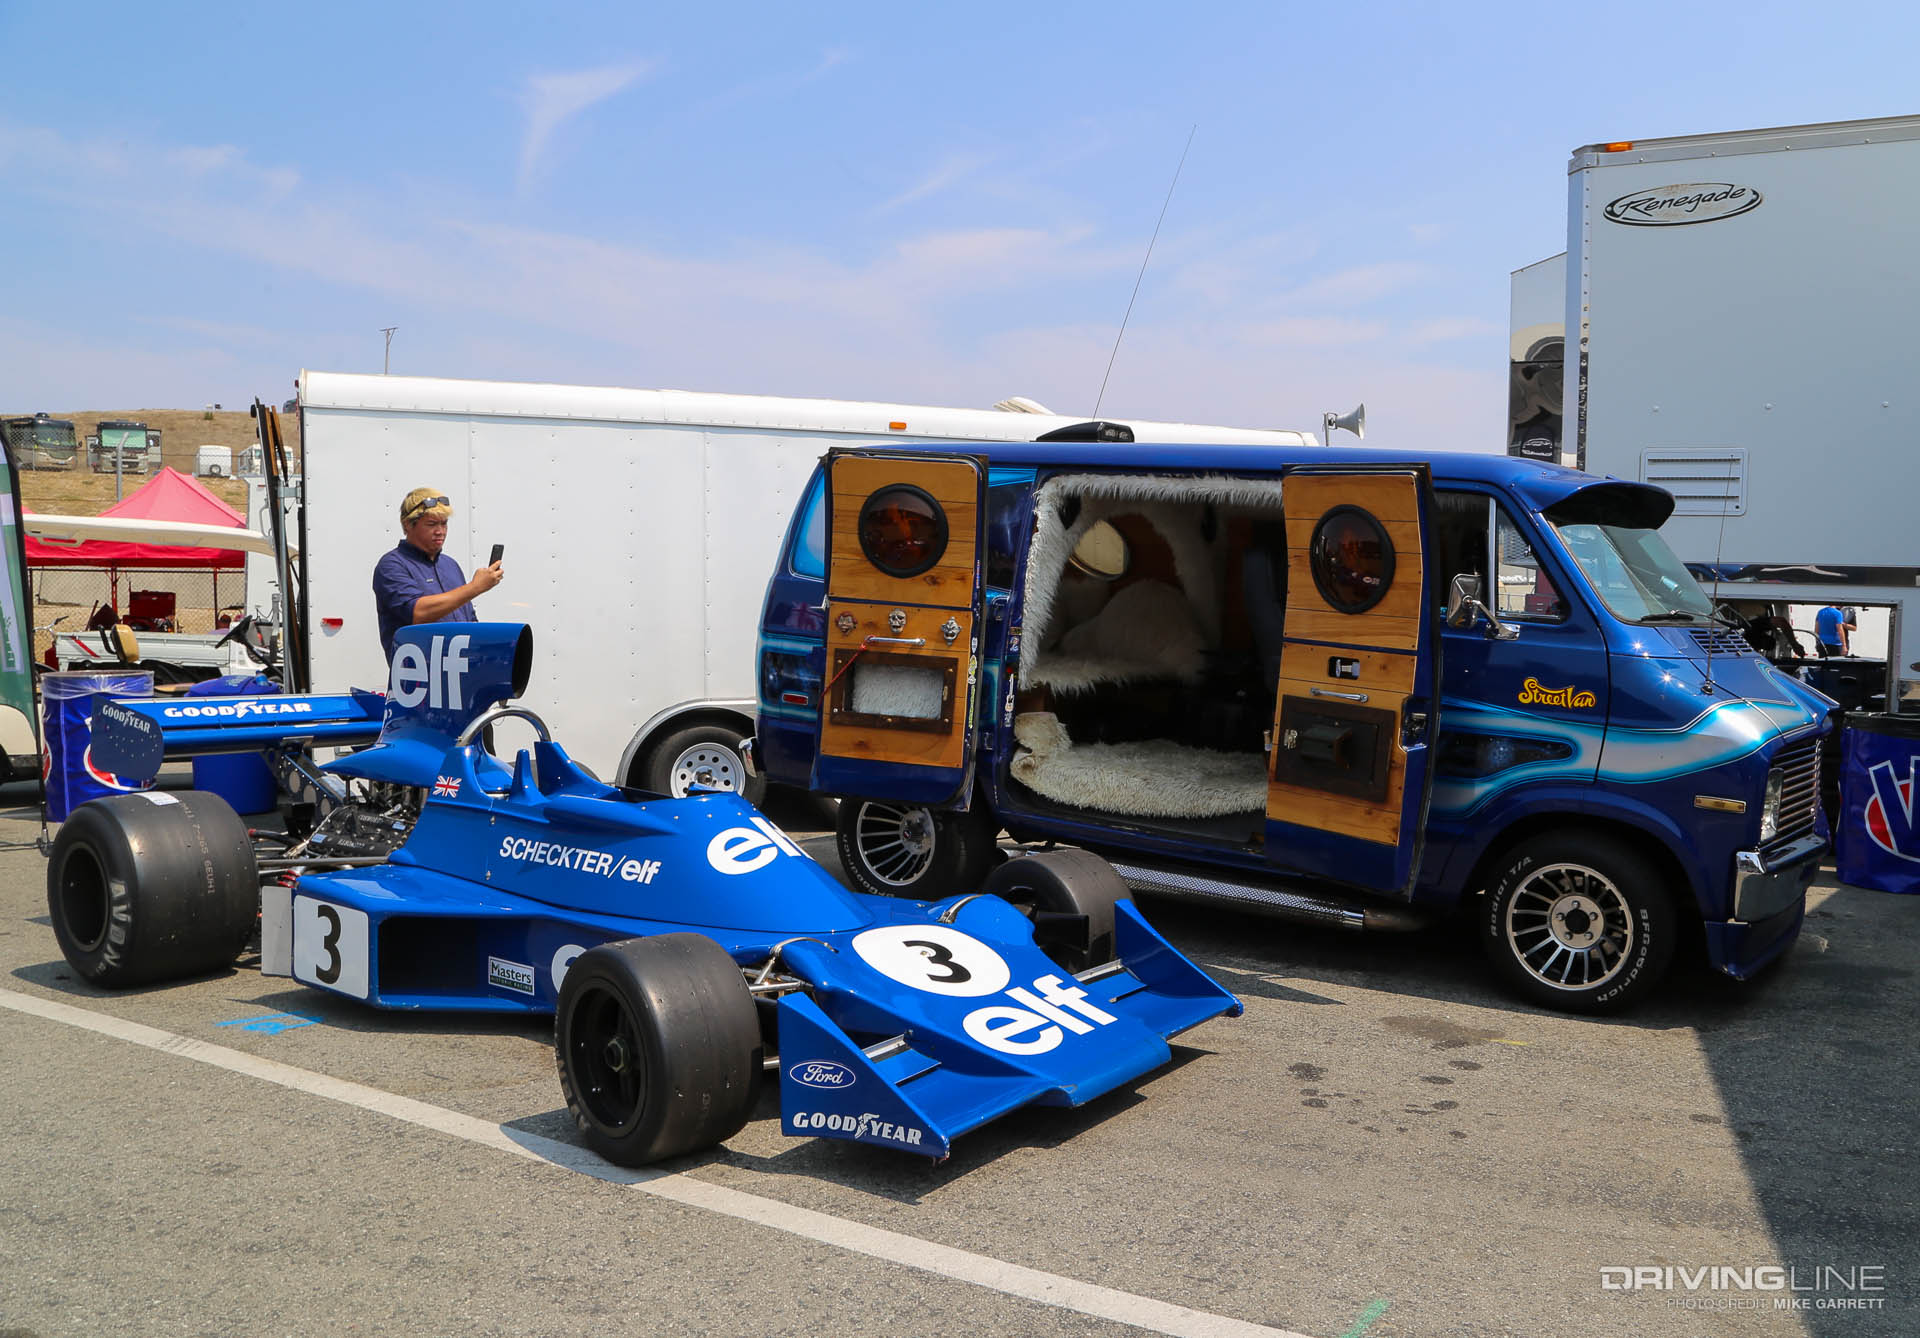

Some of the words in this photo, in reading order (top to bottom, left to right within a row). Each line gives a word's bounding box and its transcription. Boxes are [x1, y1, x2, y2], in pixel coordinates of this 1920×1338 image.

[1619, 184, 1746, 217] Renegade
[391, 635, 471, 711] elf
[707, 817, 817, 875] el
[103, 879, 132, 968] AVON
[315, 904, 342, 985] 3
[1597, 908, 1650, 1002] BFGoodrich
[491, 961, 532, 984] Masters
[902, 940, 972, 984] 3
[962, 974, 1119, 1056] elf
[802, 1063, 843, 1085] Ford
